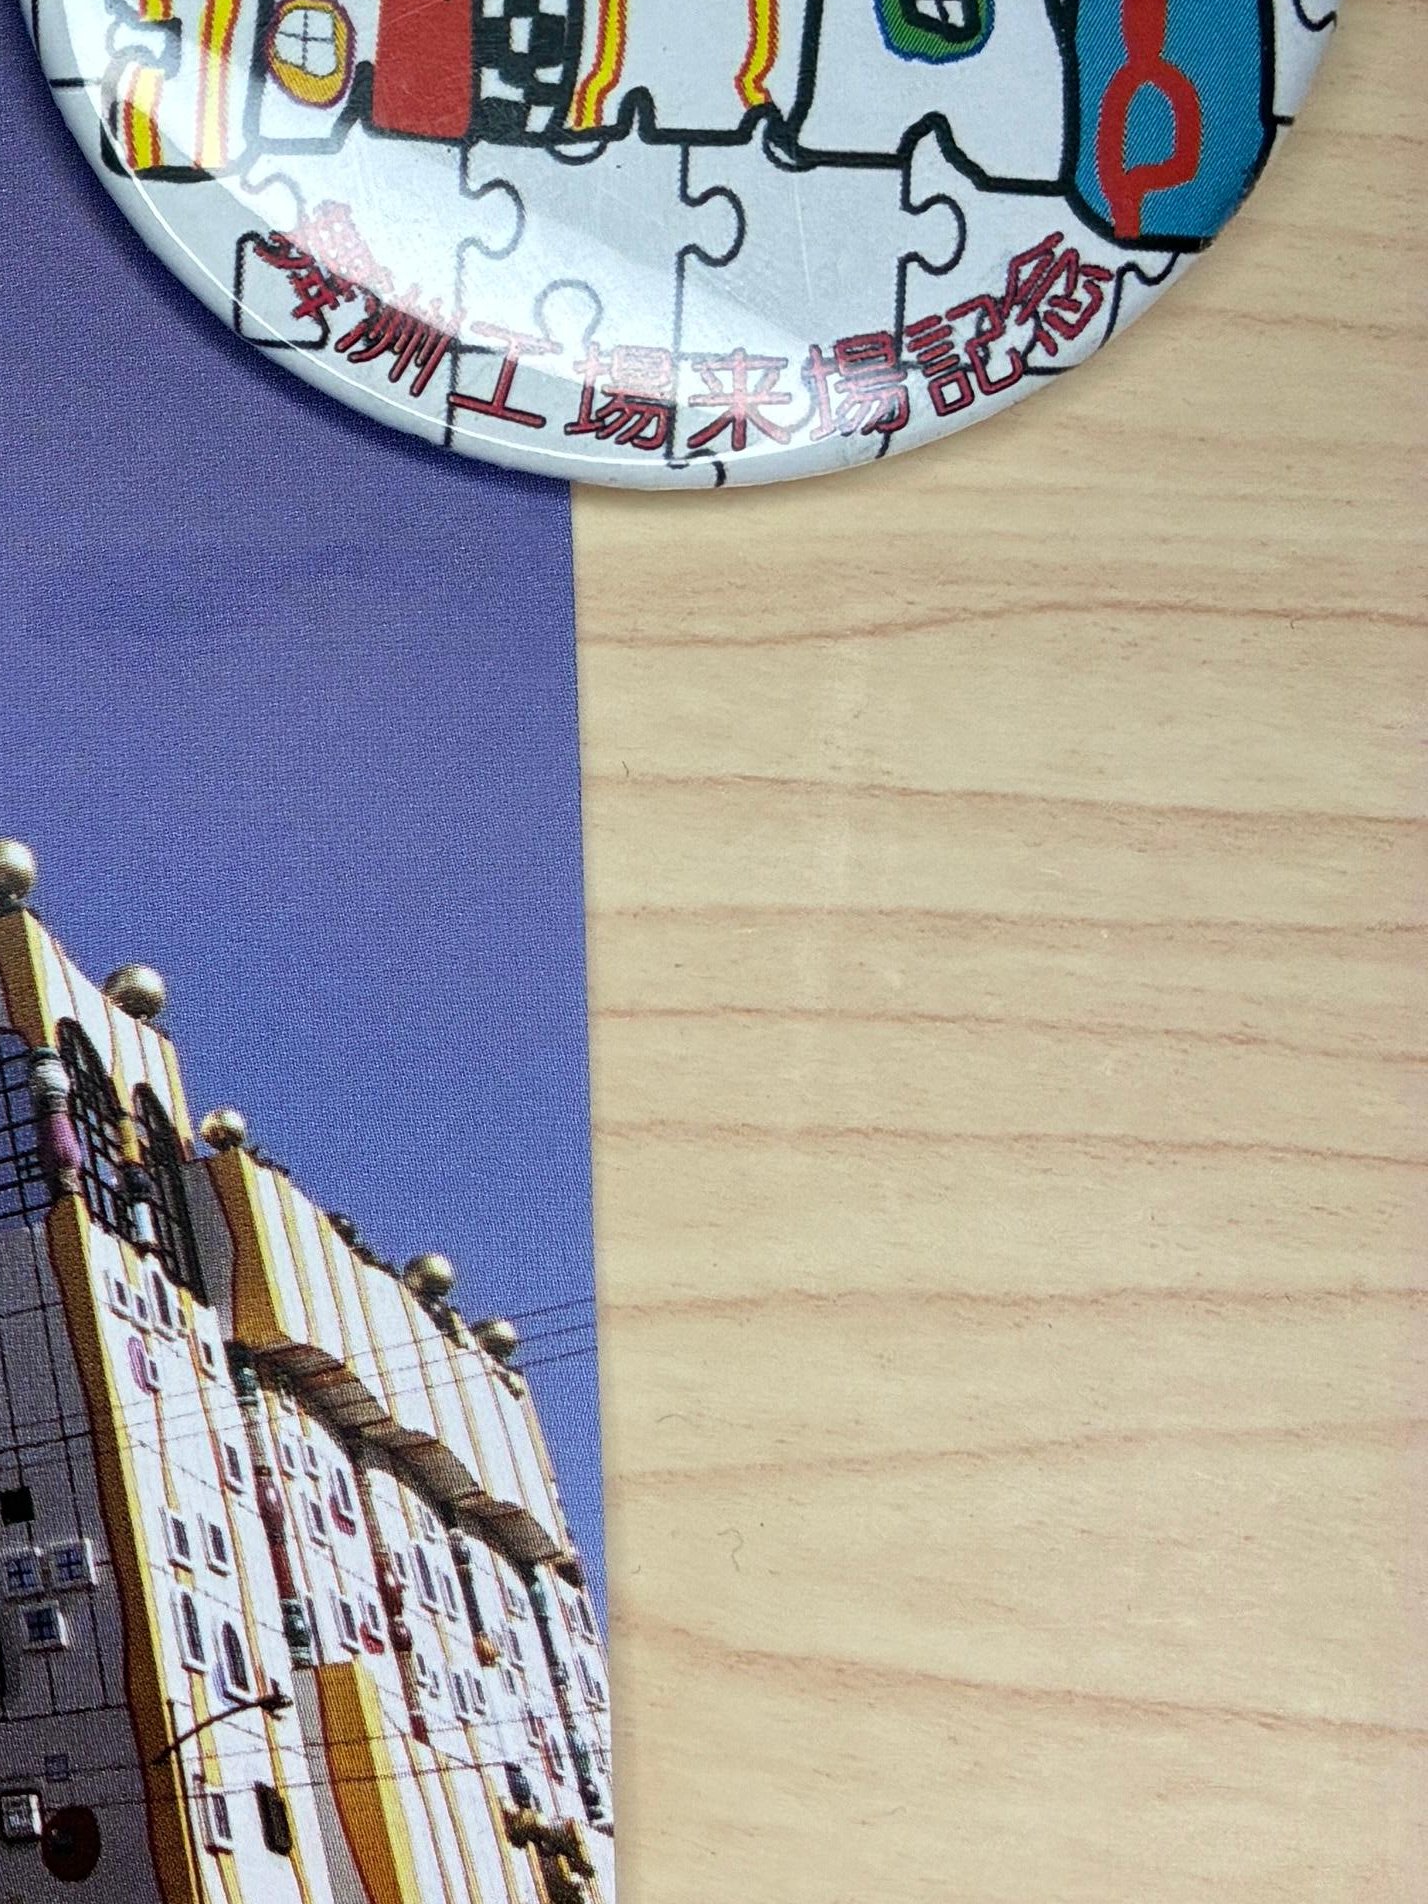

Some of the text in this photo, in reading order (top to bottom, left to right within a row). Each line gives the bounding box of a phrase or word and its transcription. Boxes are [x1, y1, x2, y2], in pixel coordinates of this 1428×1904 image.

[253, 198, 1119, 452] 舞洲工場来場記念
